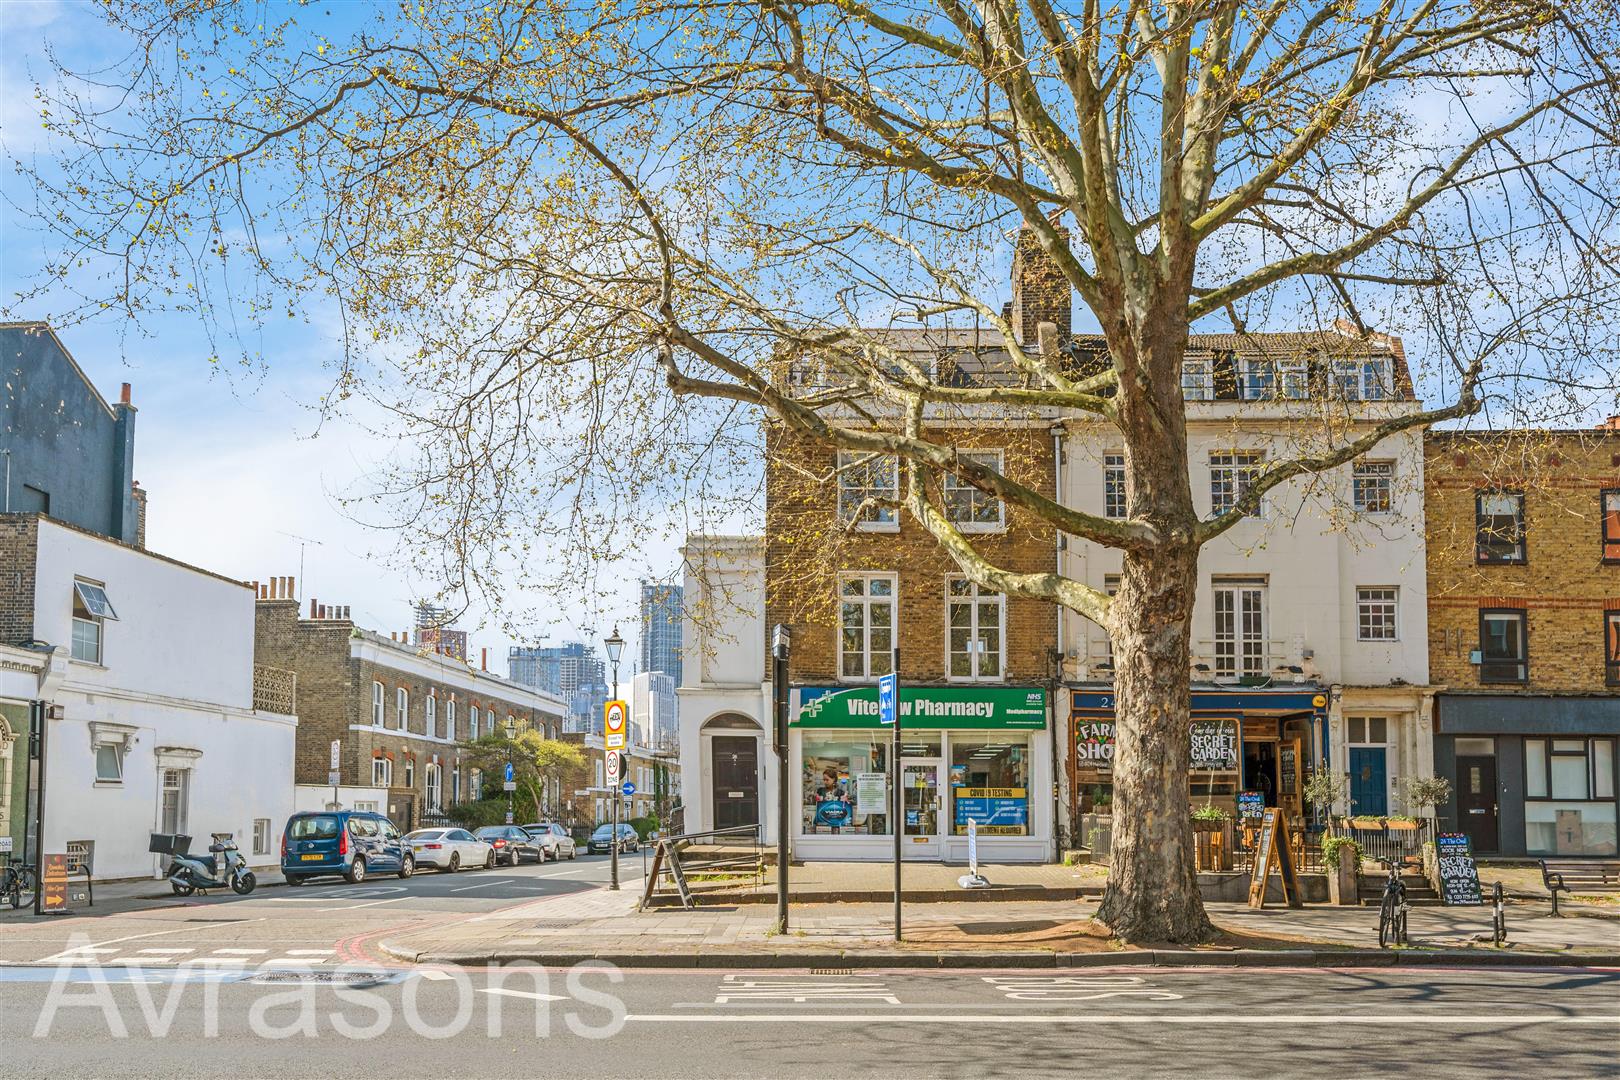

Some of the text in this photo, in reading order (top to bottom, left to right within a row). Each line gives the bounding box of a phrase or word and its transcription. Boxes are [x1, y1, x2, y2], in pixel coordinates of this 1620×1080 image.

[847, 699, 994, 718] Vitew Pharmacy
[1190, 734, 1236, 749] SECRET
[1077, 742, 1114, 760] SHO
[1190, 746, 1237, 762] GARDEN
[608, 758, 617, 768] 20
[992, 788, 1012, 797] TESTING
[1439, 855, 1474, 868] SECRET
[1440, 865, 1477, 879] GARDEN
[981, 976, 1184, 1001] BUS
